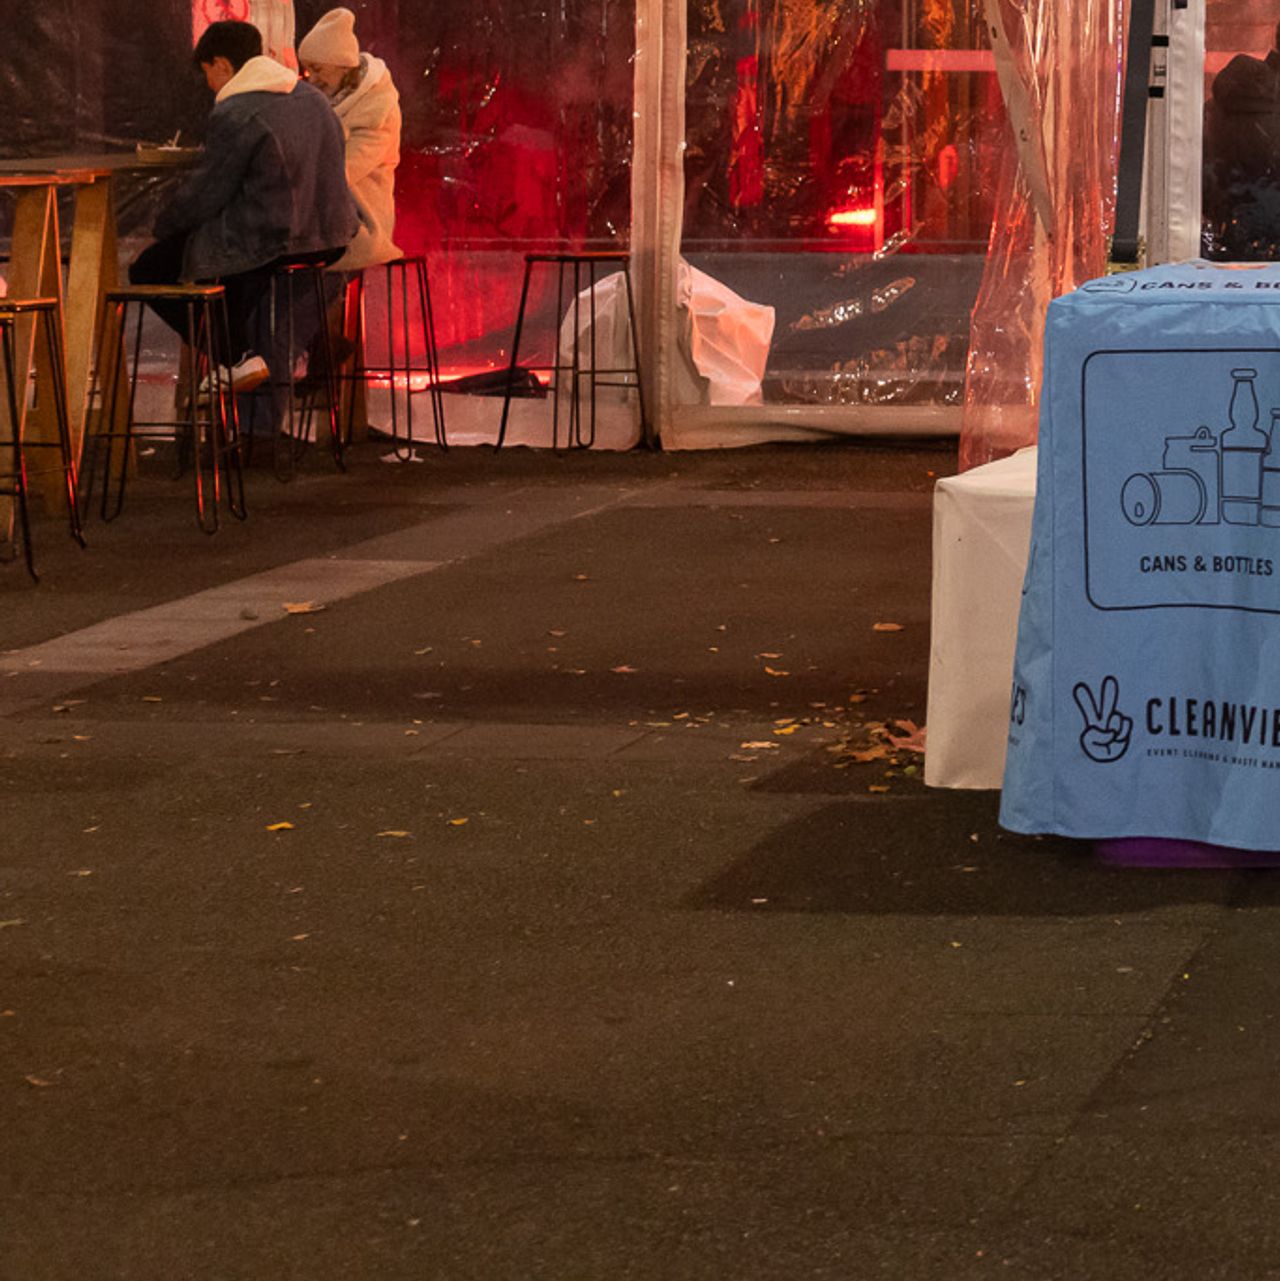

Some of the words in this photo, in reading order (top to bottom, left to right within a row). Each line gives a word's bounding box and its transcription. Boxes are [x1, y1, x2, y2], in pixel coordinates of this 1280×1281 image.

[1140, 280, 1213, 291] CANS
[1224, 280, 1244, 289] &
[1139, 555, 1187, 573] CANS
[1193, 555, 1207, 572] &
[1212, 555, 1274, 576] BOTTLES
[1147, 749, 1179, 757] EVENT
